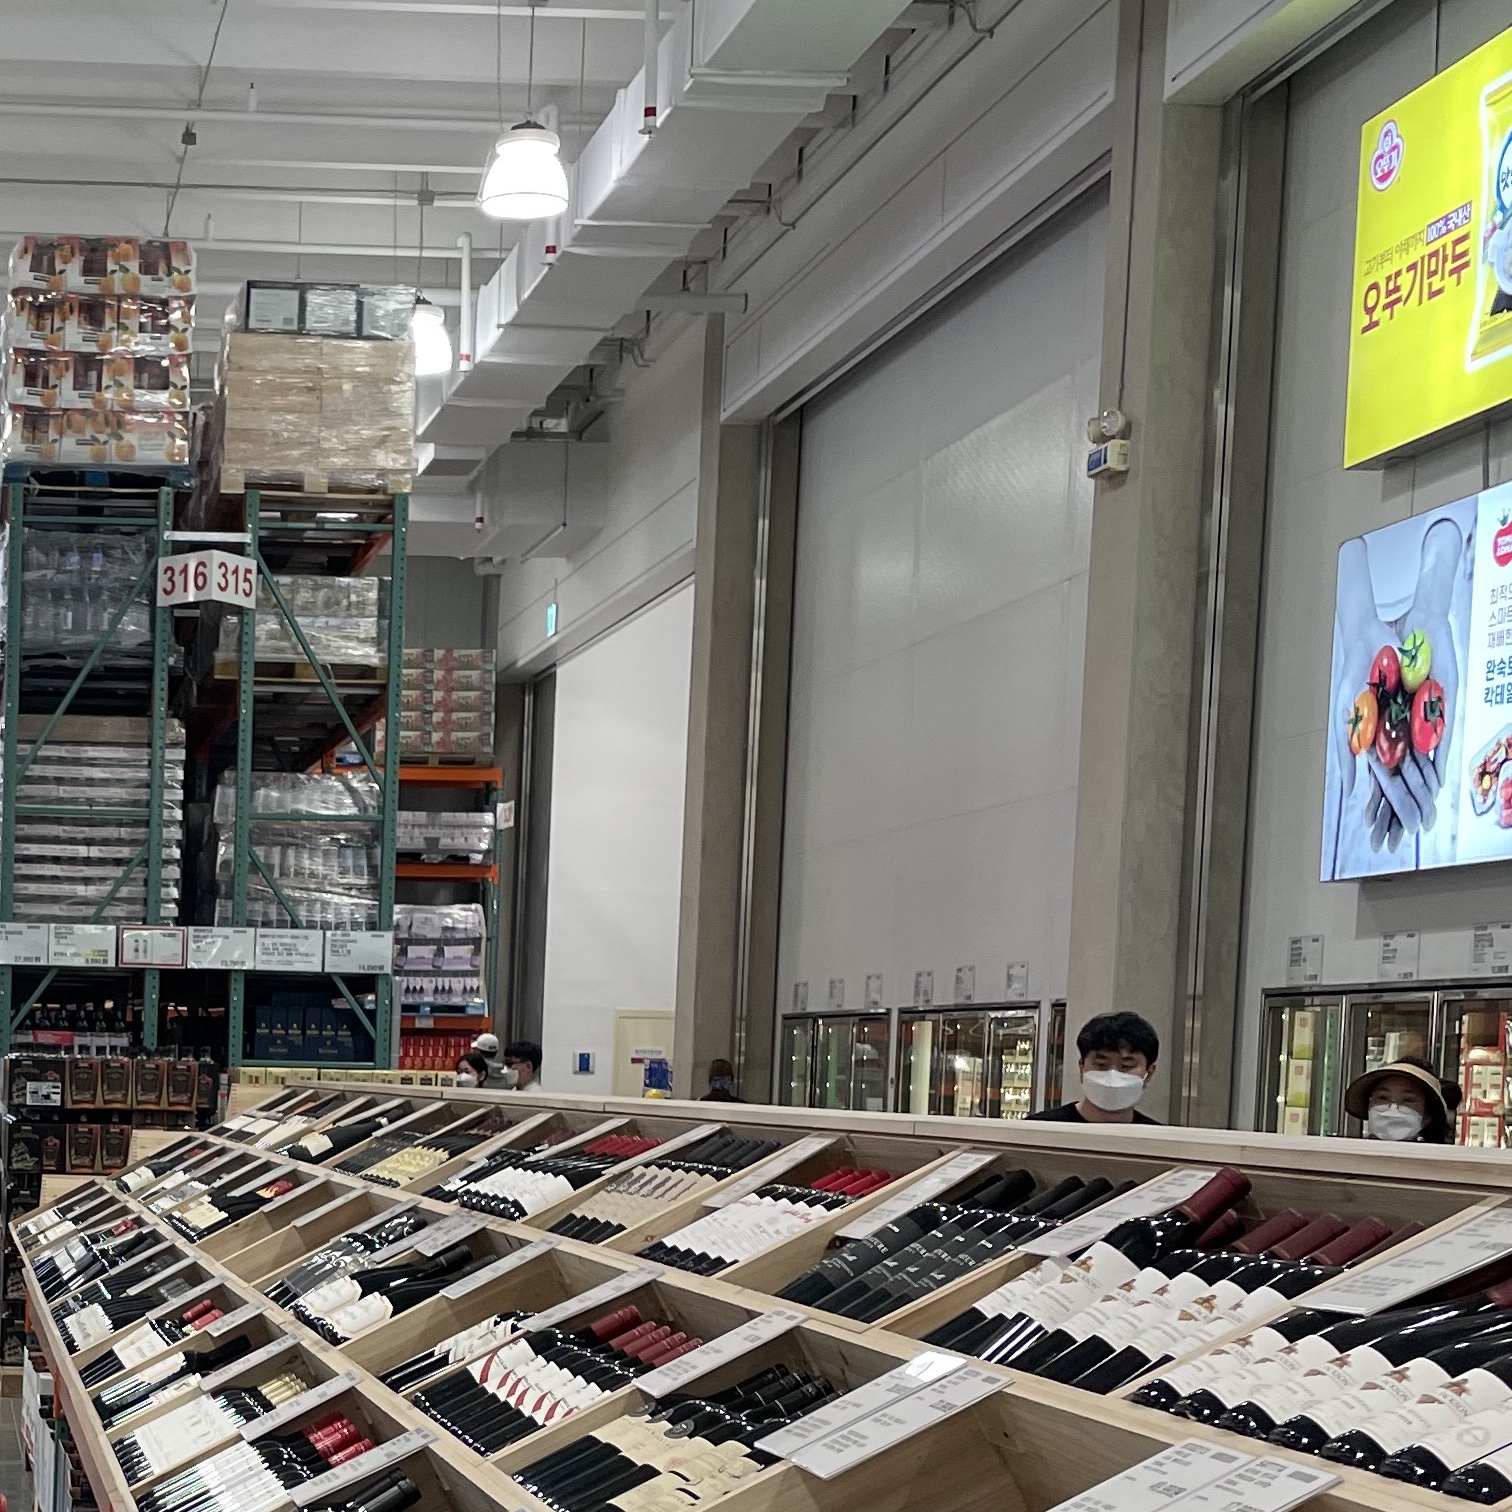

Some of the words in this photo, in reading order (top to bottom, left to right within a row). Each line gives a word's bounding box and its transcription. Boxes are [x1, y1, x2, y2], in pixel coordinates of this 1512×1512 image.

[1361, 231, 1471, 335] 오뚜기만두
[162, 561, 208, 596] 316
[216, 561, 253, 598] 315
